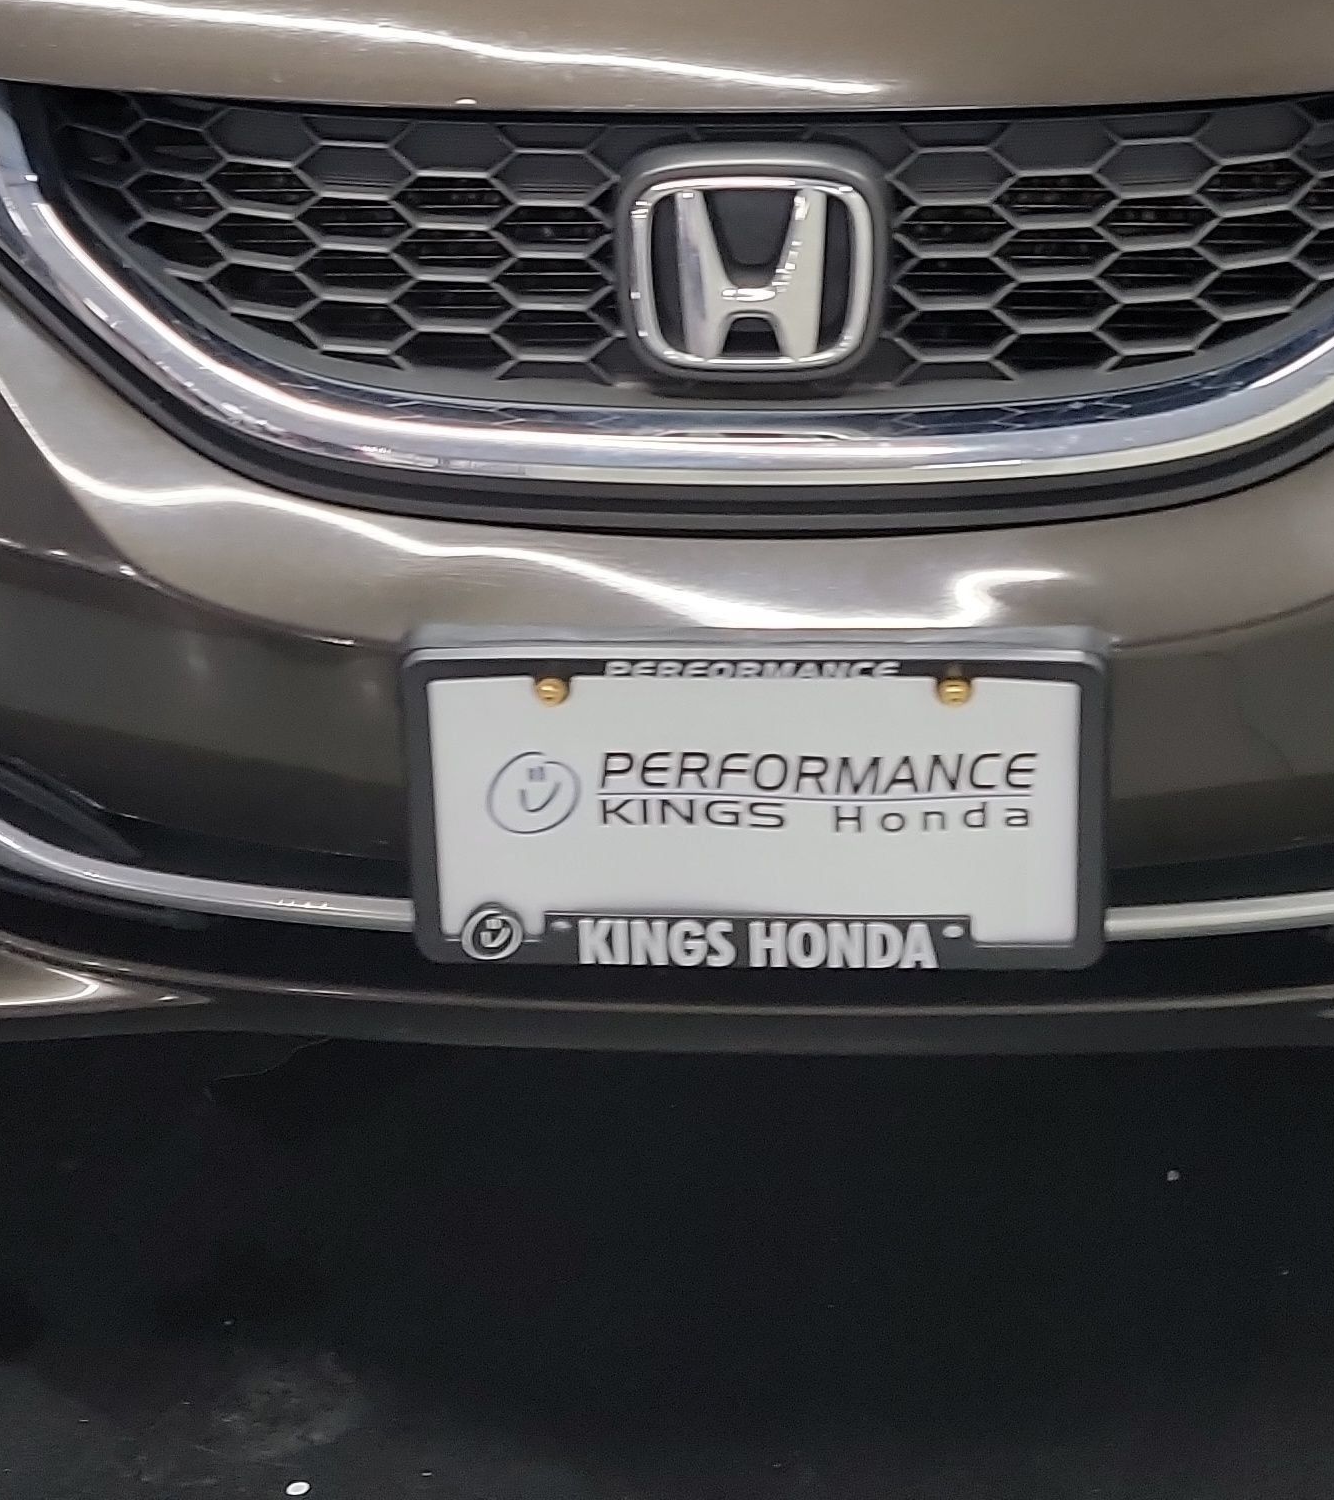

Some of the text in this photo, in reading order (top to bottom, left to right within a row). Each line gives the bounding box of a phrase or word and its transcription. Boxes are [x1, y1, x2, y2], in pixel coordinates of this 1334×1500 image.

[599, 751, 1038, 795] PERFORMANCE
[599, 799, 1031, 833] KINGS Honda
[578, 919, 940, 969] KINGS HONDA
